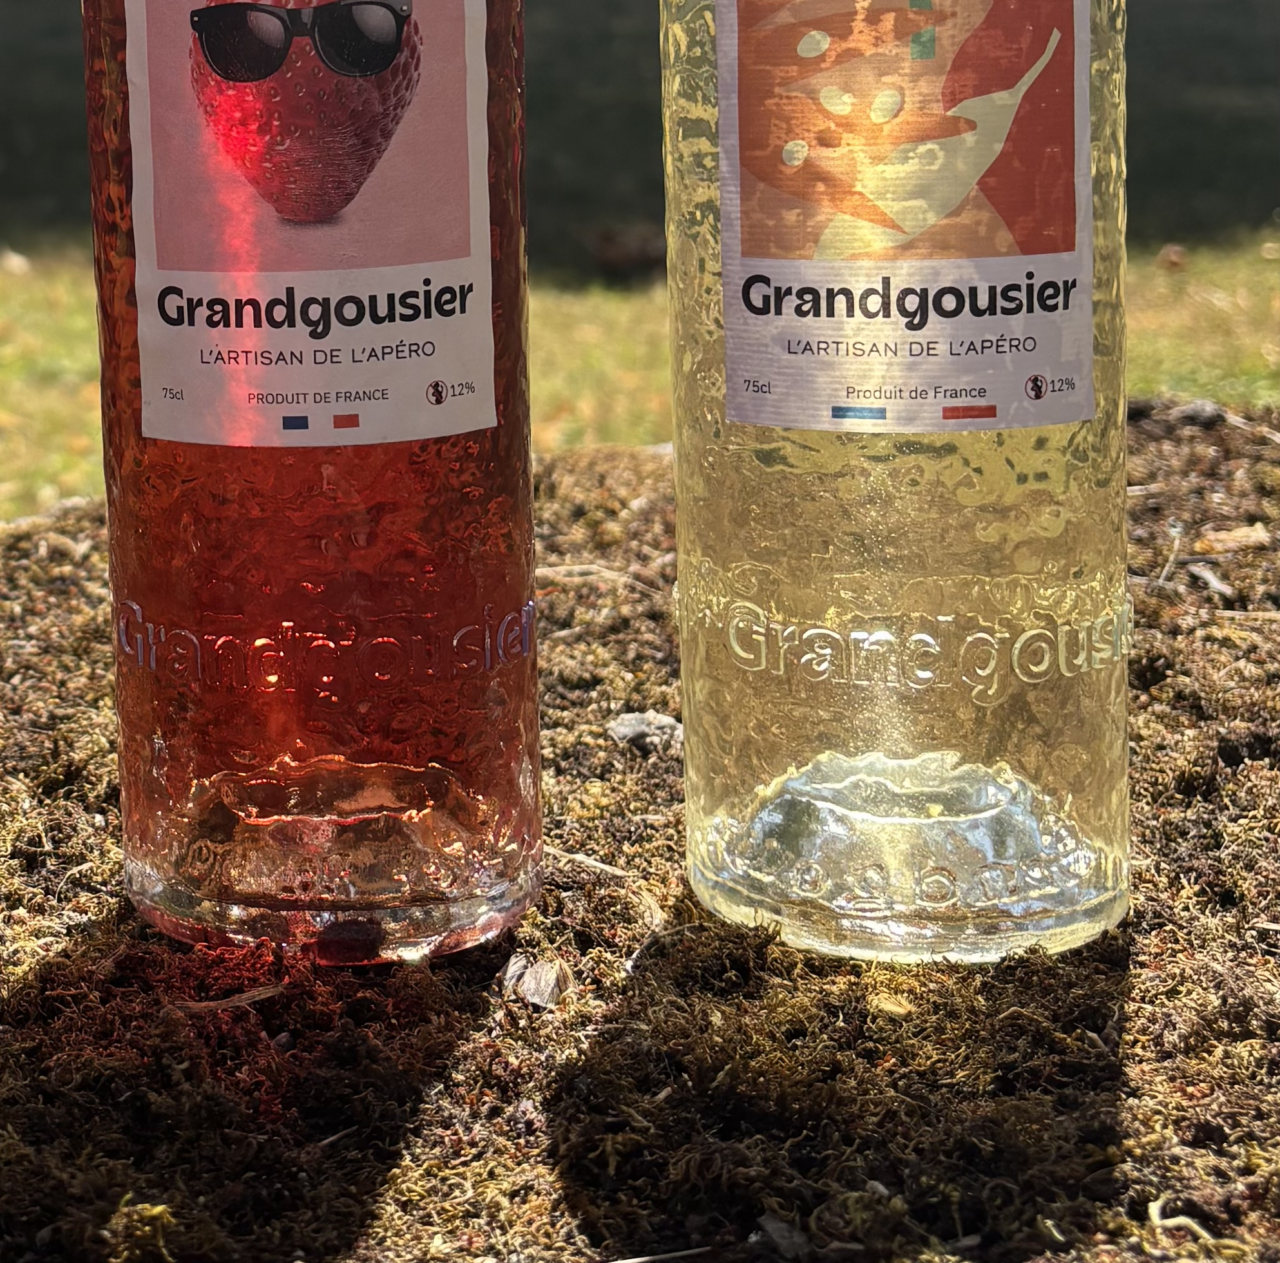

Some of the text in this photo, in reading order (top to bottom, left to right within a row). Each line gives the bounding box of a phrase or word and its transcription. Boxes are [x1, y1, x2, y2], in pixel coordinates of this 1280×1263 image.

[157, 278, 473, 340] Grandgousier
[741, 271, 1077, 331] Grandgousier
[200, 340, 436, 366] L'ARTISAN DE L'APÉRO
[787, 334, 1037, 357] L'ARTISAN DE L'APÉRO
[450, 381, 476, 397] 12%
[743, 379, 772, 395] 75cl
[846, 385, 986, 400] Produit de France
[1049, 378, 1075, 393] 12%
[162, 388, 184, 401] 75cl
[248, 389, 389, 405] PRODUIT DE FRANCE
